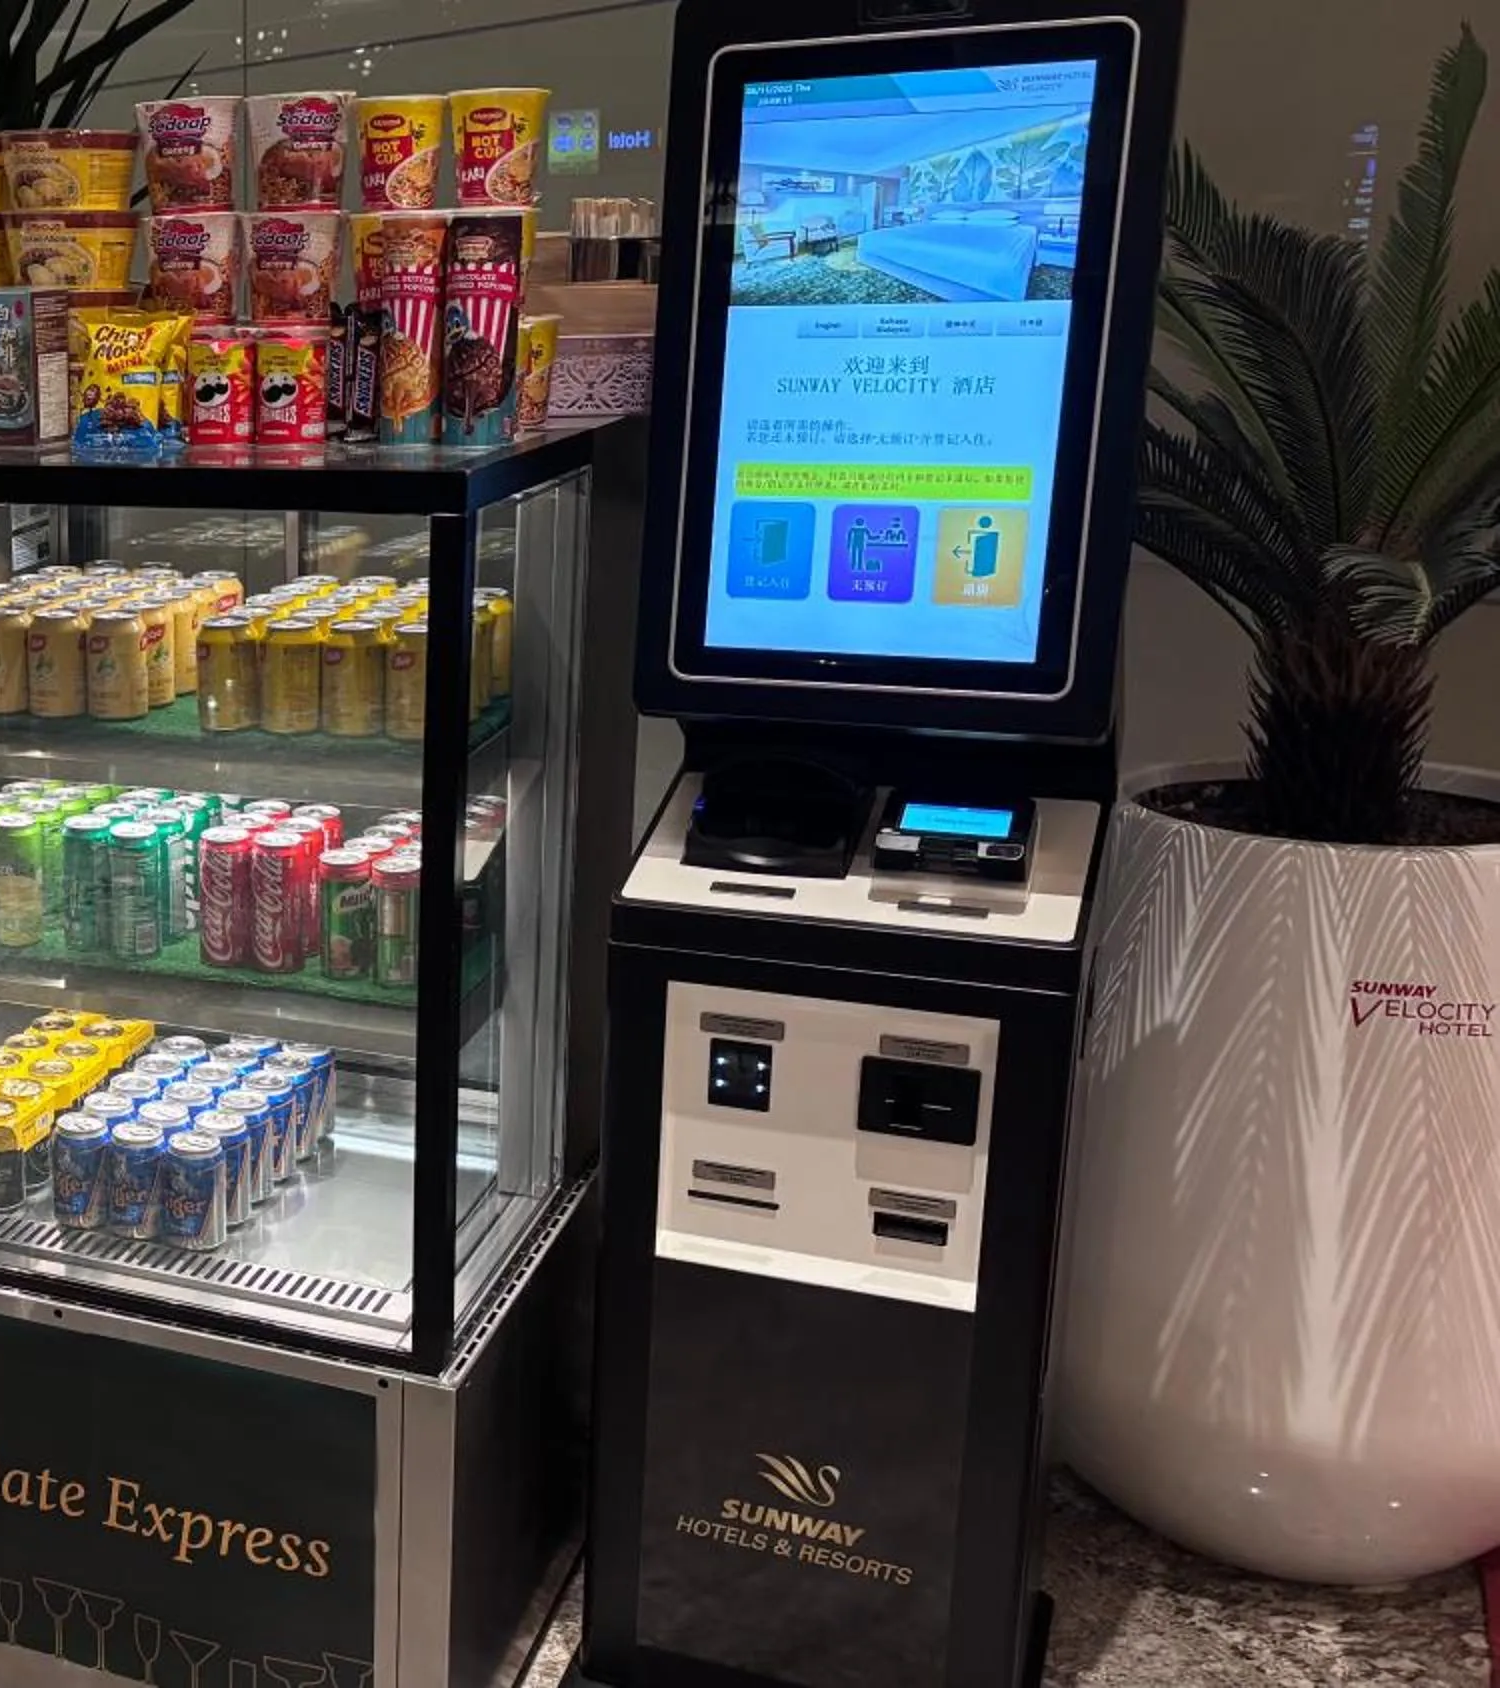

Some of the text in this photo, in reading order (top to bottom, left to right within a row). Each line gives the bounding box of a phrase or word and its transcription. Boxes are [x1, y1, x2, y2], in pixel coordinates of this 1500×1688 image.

[371, 140, 401, 153] HOT
[471, 133, 501, 147] HOT
[375, 151, 403, 165] CUP
[474, 146, 504, 159] CUP
[843, 354, 930, 376] 欢迎来到
[776, 375, 996, 396] SUNWAY VELOCITY 酒店
[1351, 980, 1437, 998] SUNWAY
[1351, 997, 1497, 1028] VELOCITY
[1418, 1022, 1493, 1037] HOTEL
[101, 1476, 332, 1578] Express
[721, 1499, 867, 1547] SUNWAY
[675, 1514, 914, 1586] HOTELS & RESORTS
